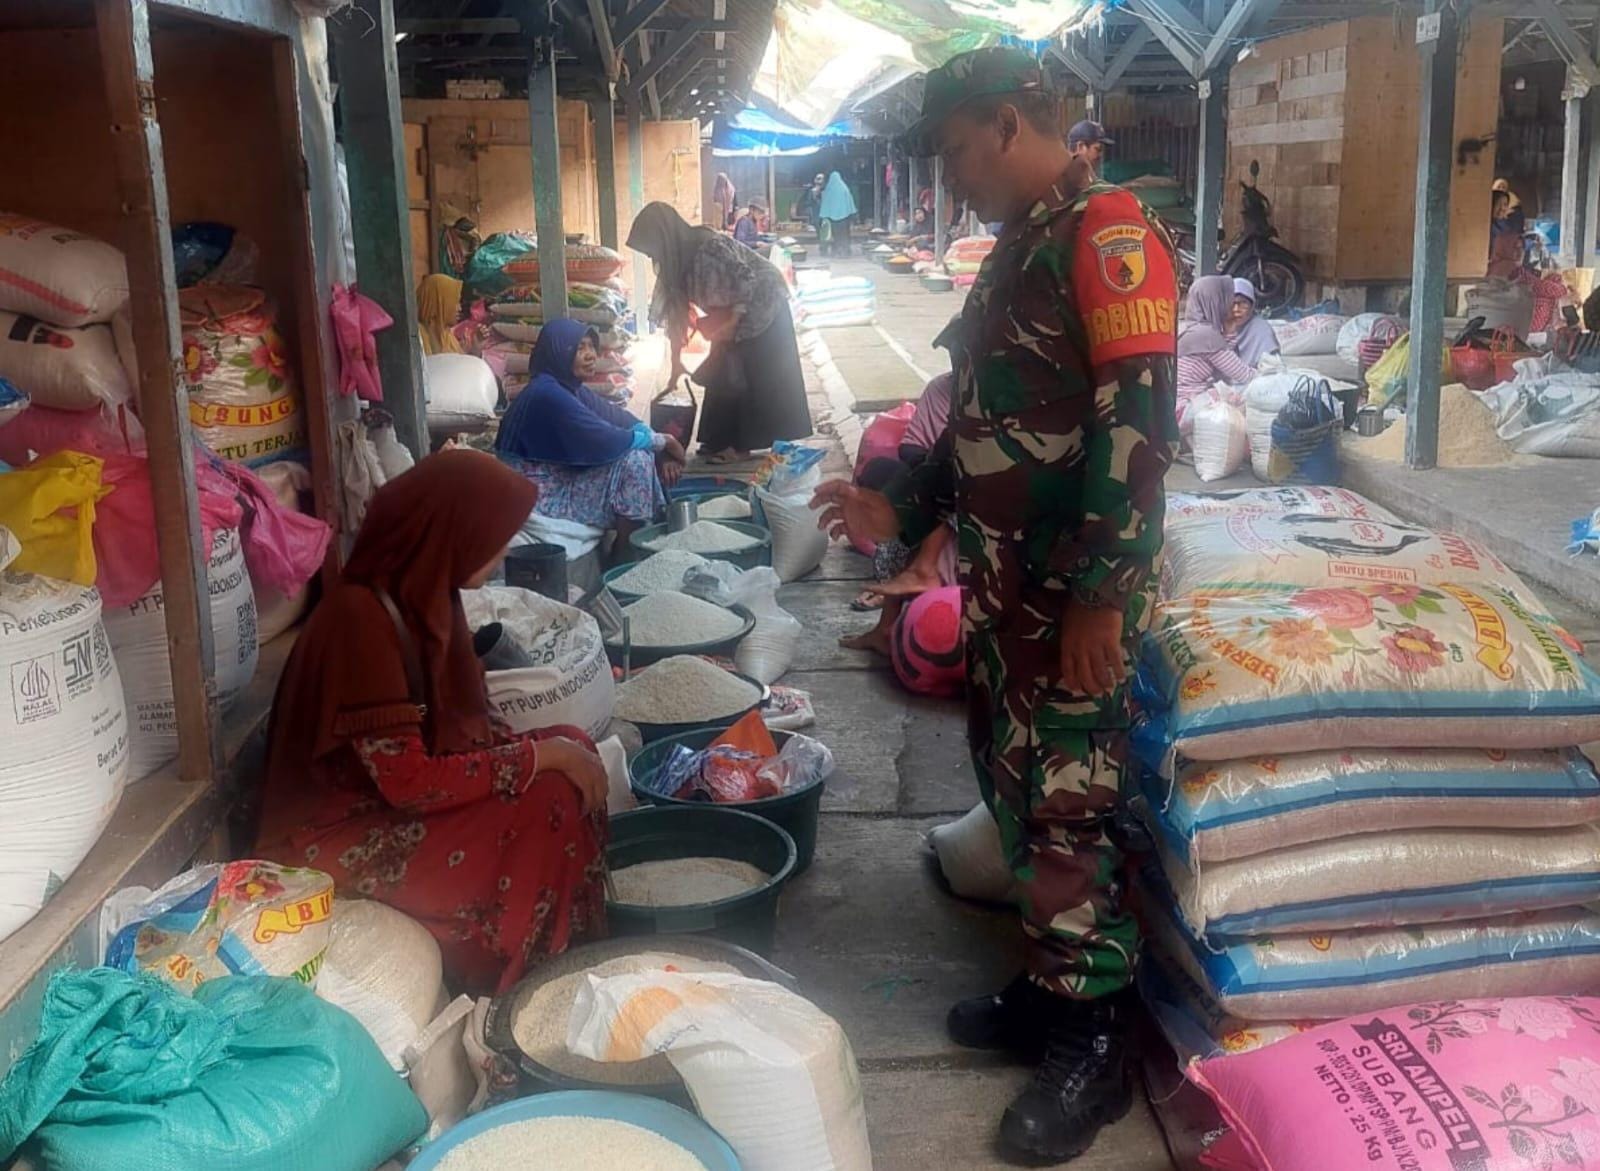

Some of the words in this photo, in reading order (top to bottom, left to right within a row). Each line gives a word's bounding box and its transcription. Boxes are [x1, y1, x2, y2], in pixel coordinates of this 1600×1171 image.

[217, 444, 248, 460] TU
[1367, 566, 1410, 581] SPESIAL
[1210, 639, 1281, 685] BERAS
[499, 698, 519, 716] PT
[517, 686, 562, 712] PUPUK
[1313, 1064, 1351, 1104] NETTO
[1350, 1114, 1372, 1134] 25
[1364, 1136, 1384, 1161] Kg
[1351, 1045, 1437, 1151] SUBANG
[1378, 1030, 1415, 1061] SRI
[1402, 1065, 1481, 1151] AMPELI
